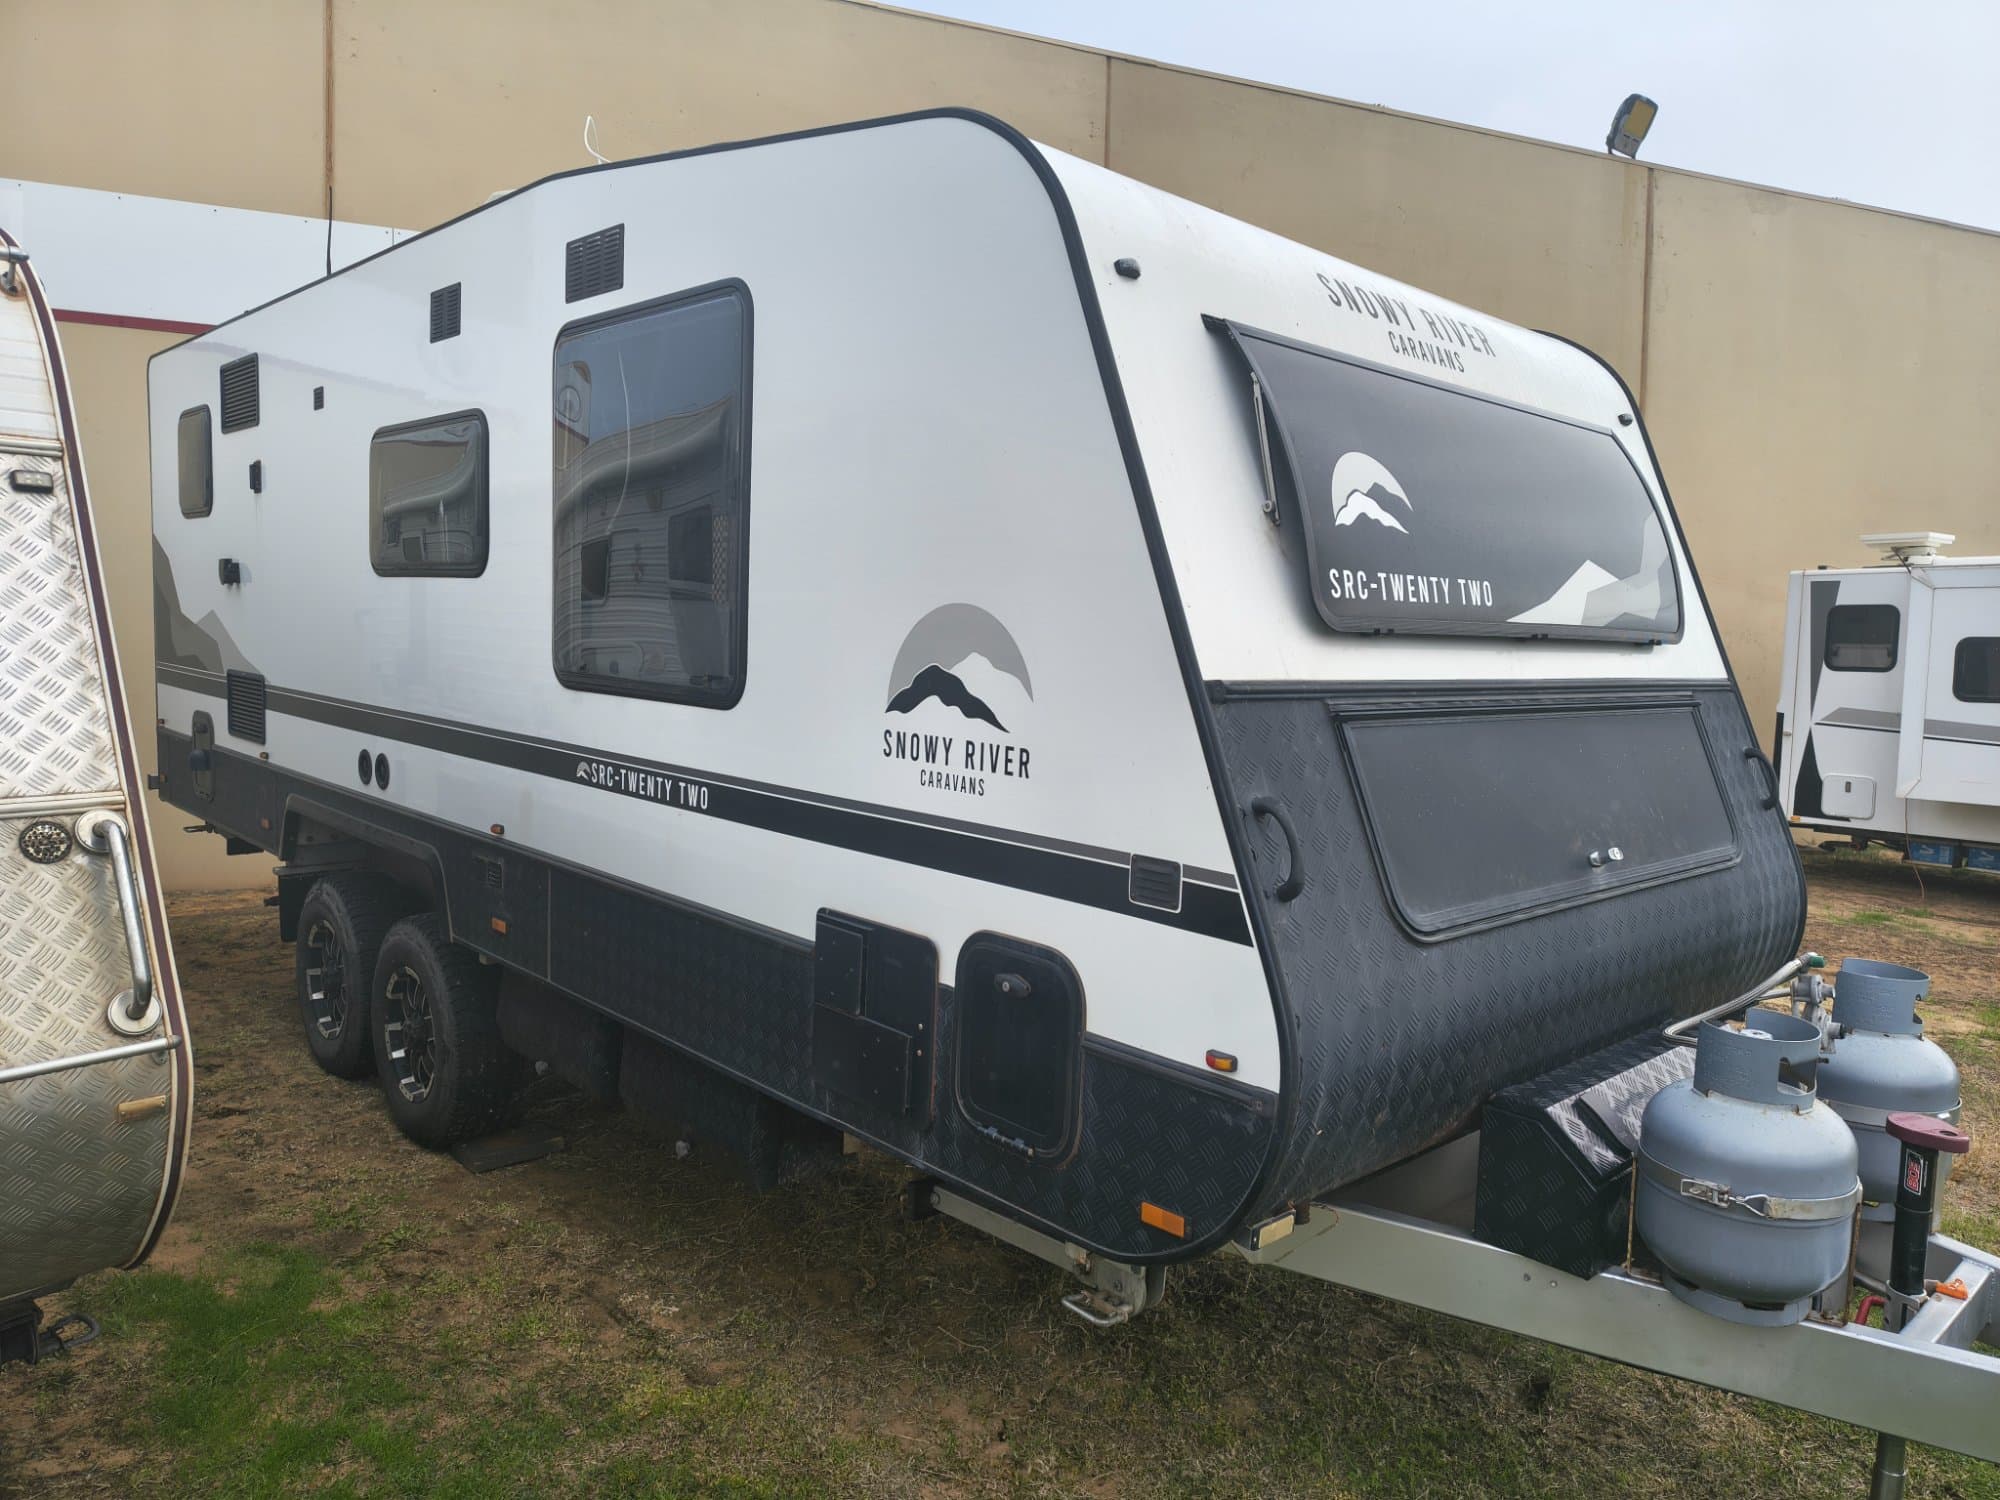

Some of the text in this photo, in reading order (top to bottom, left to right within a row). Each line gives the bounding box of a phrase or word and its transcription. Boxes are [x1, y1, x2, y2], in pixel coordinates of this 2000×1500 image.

[1316, 272, 1497, 358] SNOWY RIVER
[1387, 330, 1465, 373] CARAVANS
[1329, 568, 1493, 607] SRC-TWENTY TWO
[882, 729, 1031, 780] SNOWY RIVER
[591, 762, 709, 810] SRC-TWENTY TWO
[920, 769, 986, 797] CARAVANS
